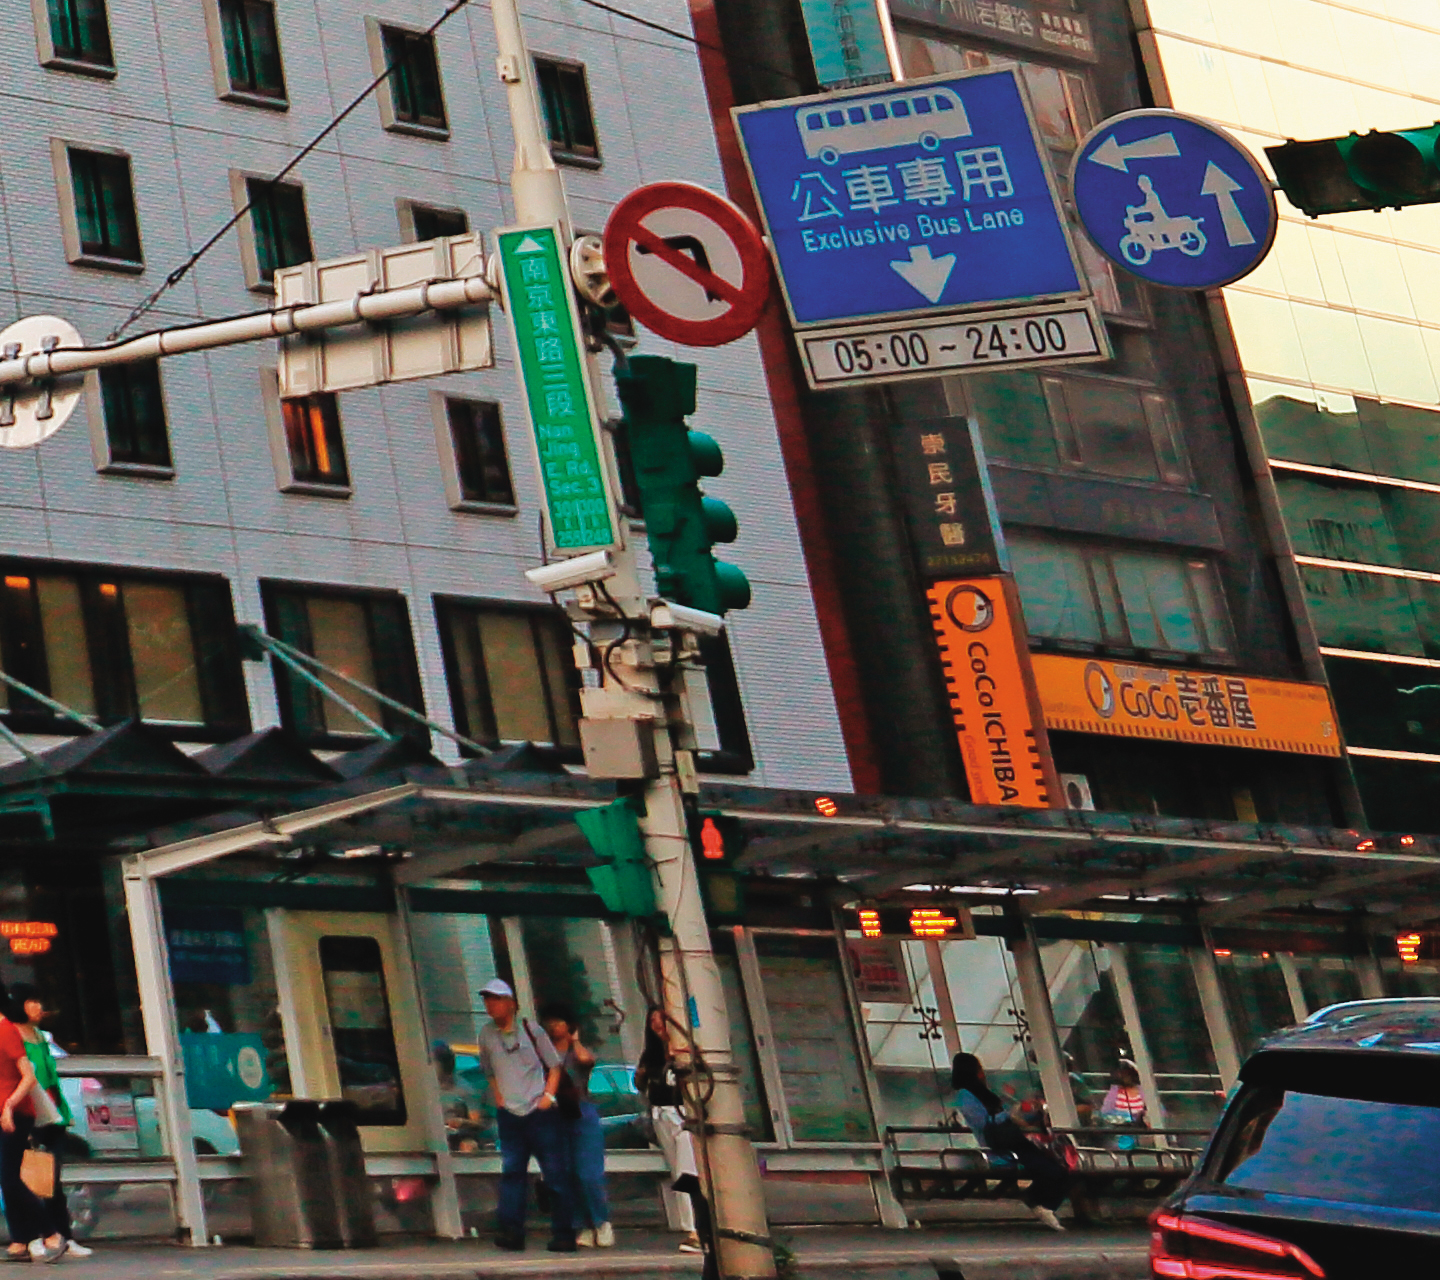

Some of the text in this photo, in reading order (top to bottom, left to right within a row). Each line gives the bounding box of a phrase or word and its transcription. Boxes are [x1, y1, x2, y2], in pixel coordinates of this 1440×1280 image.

[791, 145, 1015, 222] 公車專用
[801, 208, 1024, 252] Exclusive Bus Lane
[519, 257, 576, 418] 南京東路三段
[834, 332, 929, 374] 05:00
[966, 318, 1067, 361] 24:00
[967, 641, 996, 707] CoCo
